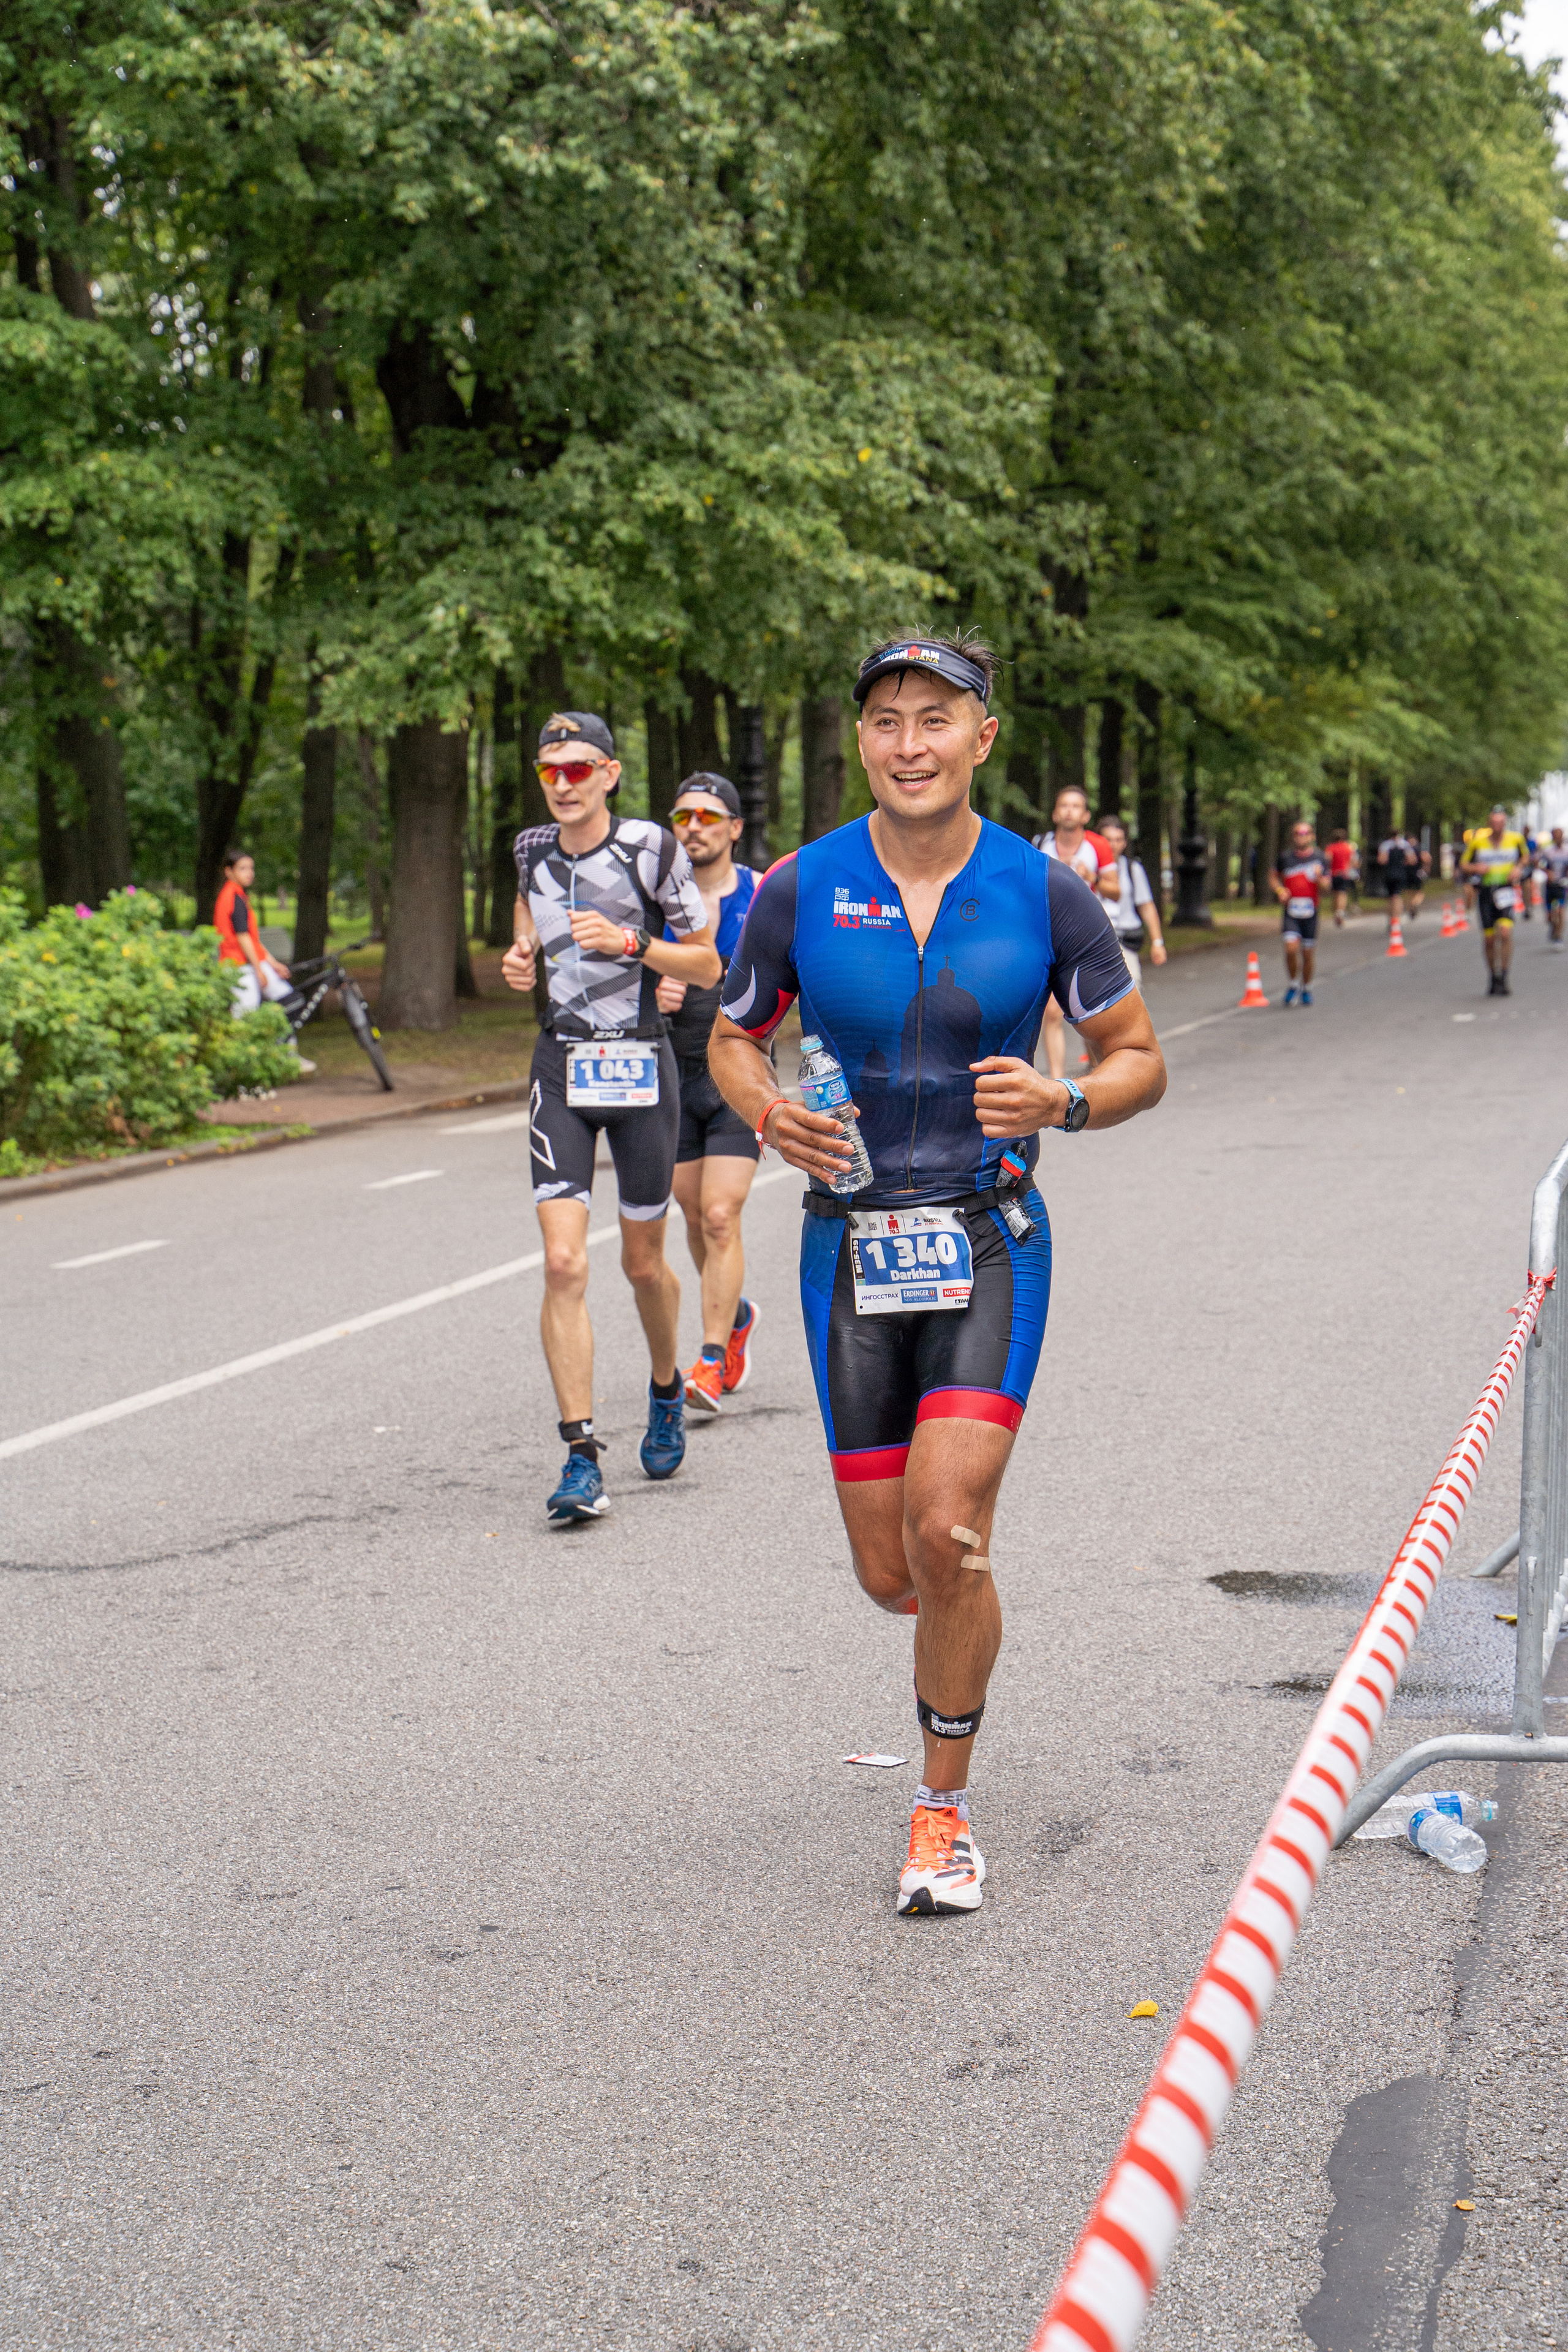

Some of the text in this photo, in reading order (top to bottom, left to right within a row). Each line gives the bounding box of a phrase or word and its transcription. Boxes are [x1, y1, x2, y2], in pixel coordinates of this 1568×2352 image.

[881, 646, 940, 663] RONMAN
[884, 647, 903, 657] GROUP
[833, 897, 902, 919] IRONMAN
[833, 914, 861, 929] 70.3
[592, 1030, 625, 1040] 2XU
[853, 1239, 863, 1273] M35-39
[890, 1268, 941, 1281] Darkhan
[931, 1717, 973, 1730] IRONMAN
[931, 1724, 946, 1734] 70.3
